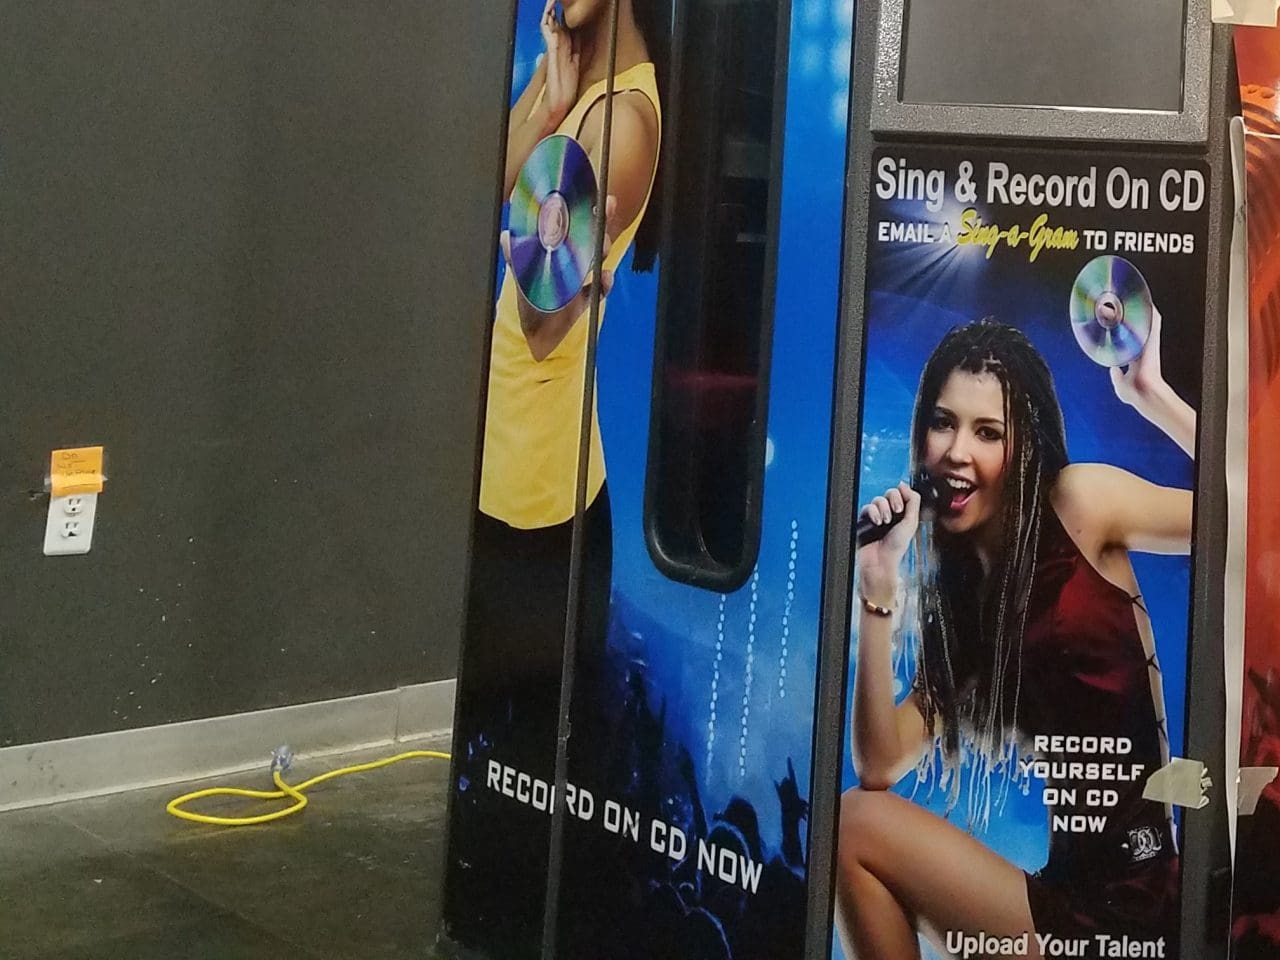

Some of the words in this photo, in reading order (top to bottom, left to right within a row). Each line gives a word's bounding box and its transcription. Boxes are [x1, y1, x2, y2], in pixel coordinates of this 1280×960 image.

[875, 157, 945, 212] Sing
[954, 160, 977, 203] &
[987, 162, 1097, 207] Record
[1106, 167, 1148, 209] On
[1159, 169, 1205, 212] CD
[878, 222, 935, 242] EMAIL
[939, 221, 952, 243] A
[957, 207, 1080, 263] Sing-a-Gram
[1083, 230, 1107, 250] TO
[1114, 231, 1194, 254] FRIENDS
[1034, 735, 1132, 754] RECORD
[1019, 761, 1145, 781] YOURSELF
[1042, 788, 1081, 806] ON
[1086, 790, 1119, 807] CD
[487, 759, 594, 821] RECORD
[604, 799, 640, 842] ON
[650, 819, 686, 860] CD
[698, 838, 763, 895] NOW
[1052, 815, 1107, 833] NOW
[945, 931, 1029, 959] Upload
[1035, 933, 1089, 957] Your
[1095, 935, 1165, 959] Talent
